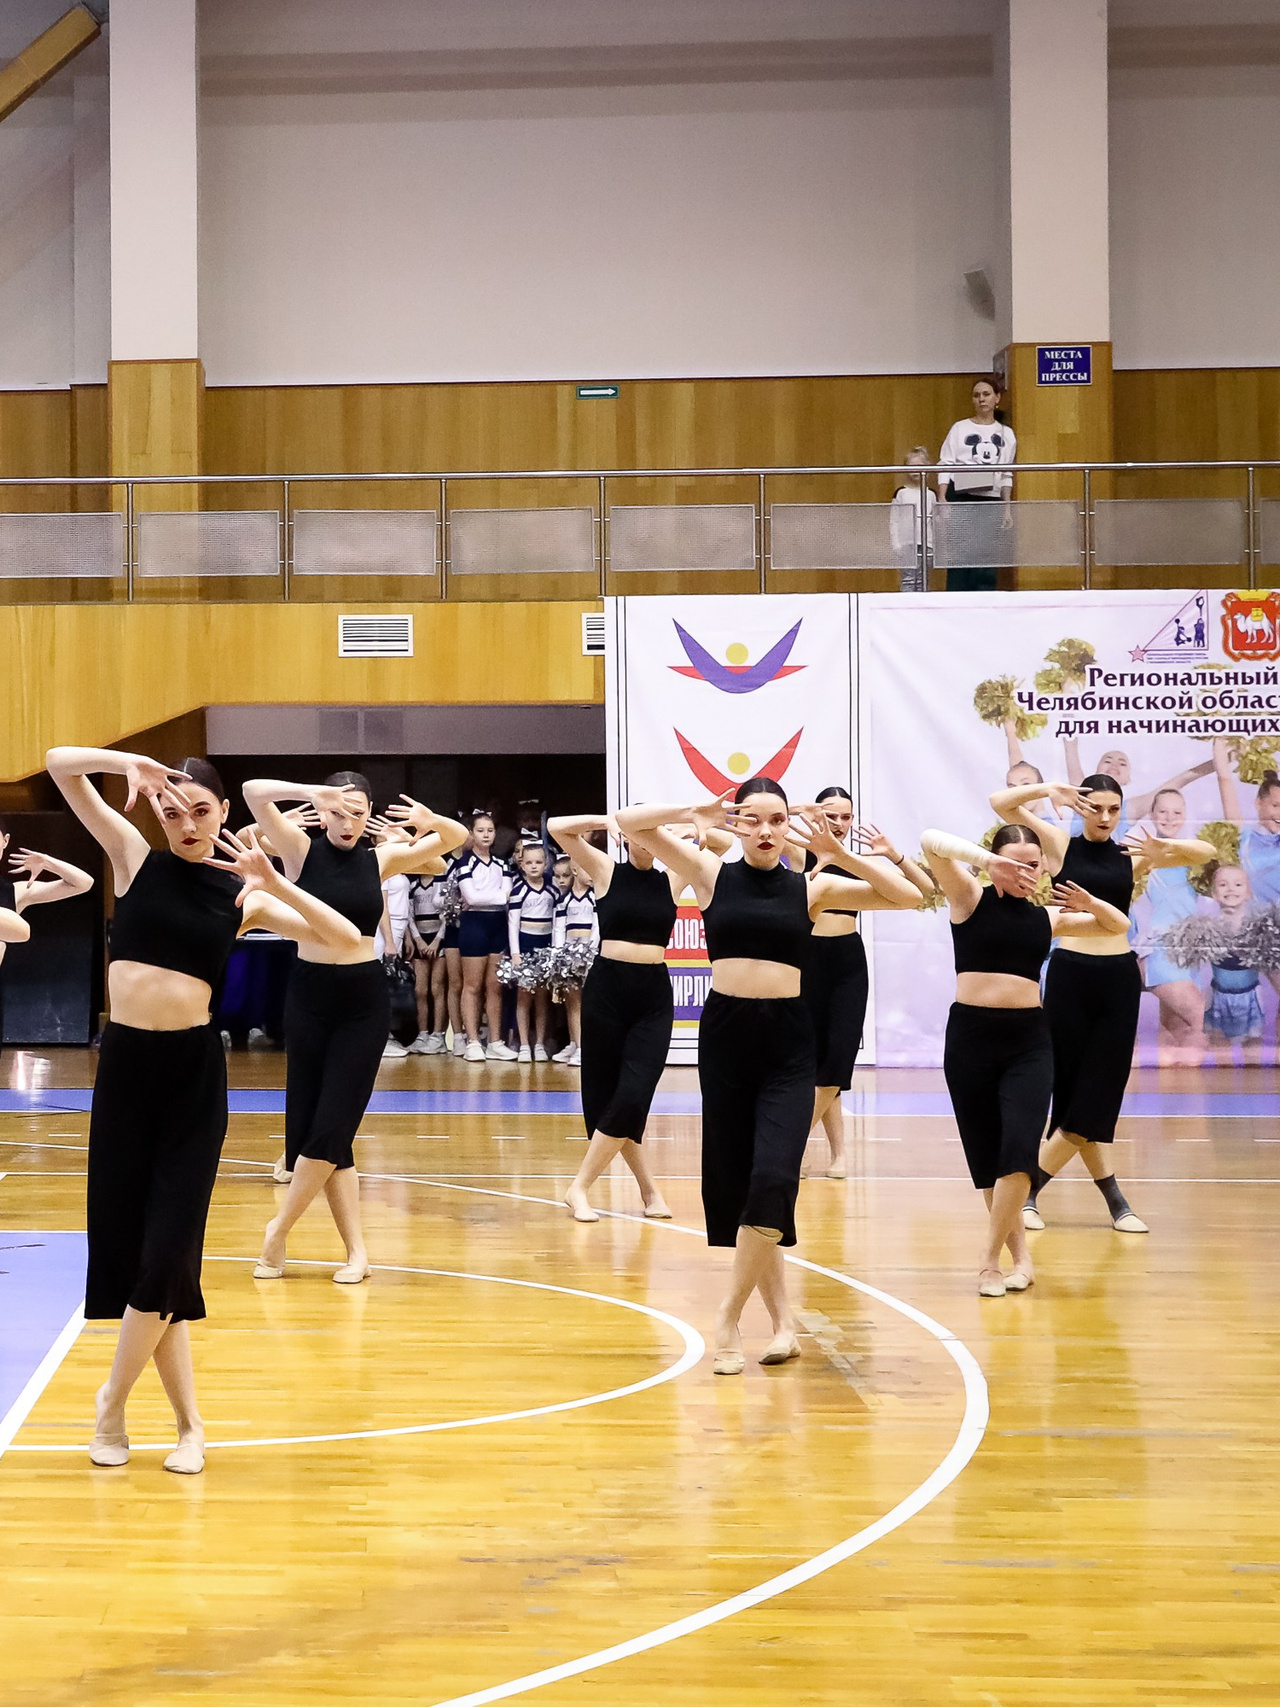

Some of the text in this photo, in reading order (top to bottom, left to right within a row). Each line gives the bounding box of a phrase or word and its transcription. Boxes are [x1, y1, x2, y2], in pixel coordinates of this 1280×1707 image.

[1044, 350, 1083, 359] МЕСТА
[1051, 361, 1074, 371] ДЛЯ
[1041, 372, 1088, 381] ПРЕССЫ
[1089, 666, 1278, 687] Региональный
[1017, 689, 1280, 711] Челябинской облас
[1055, 719, 1280, 738] для начинающих
